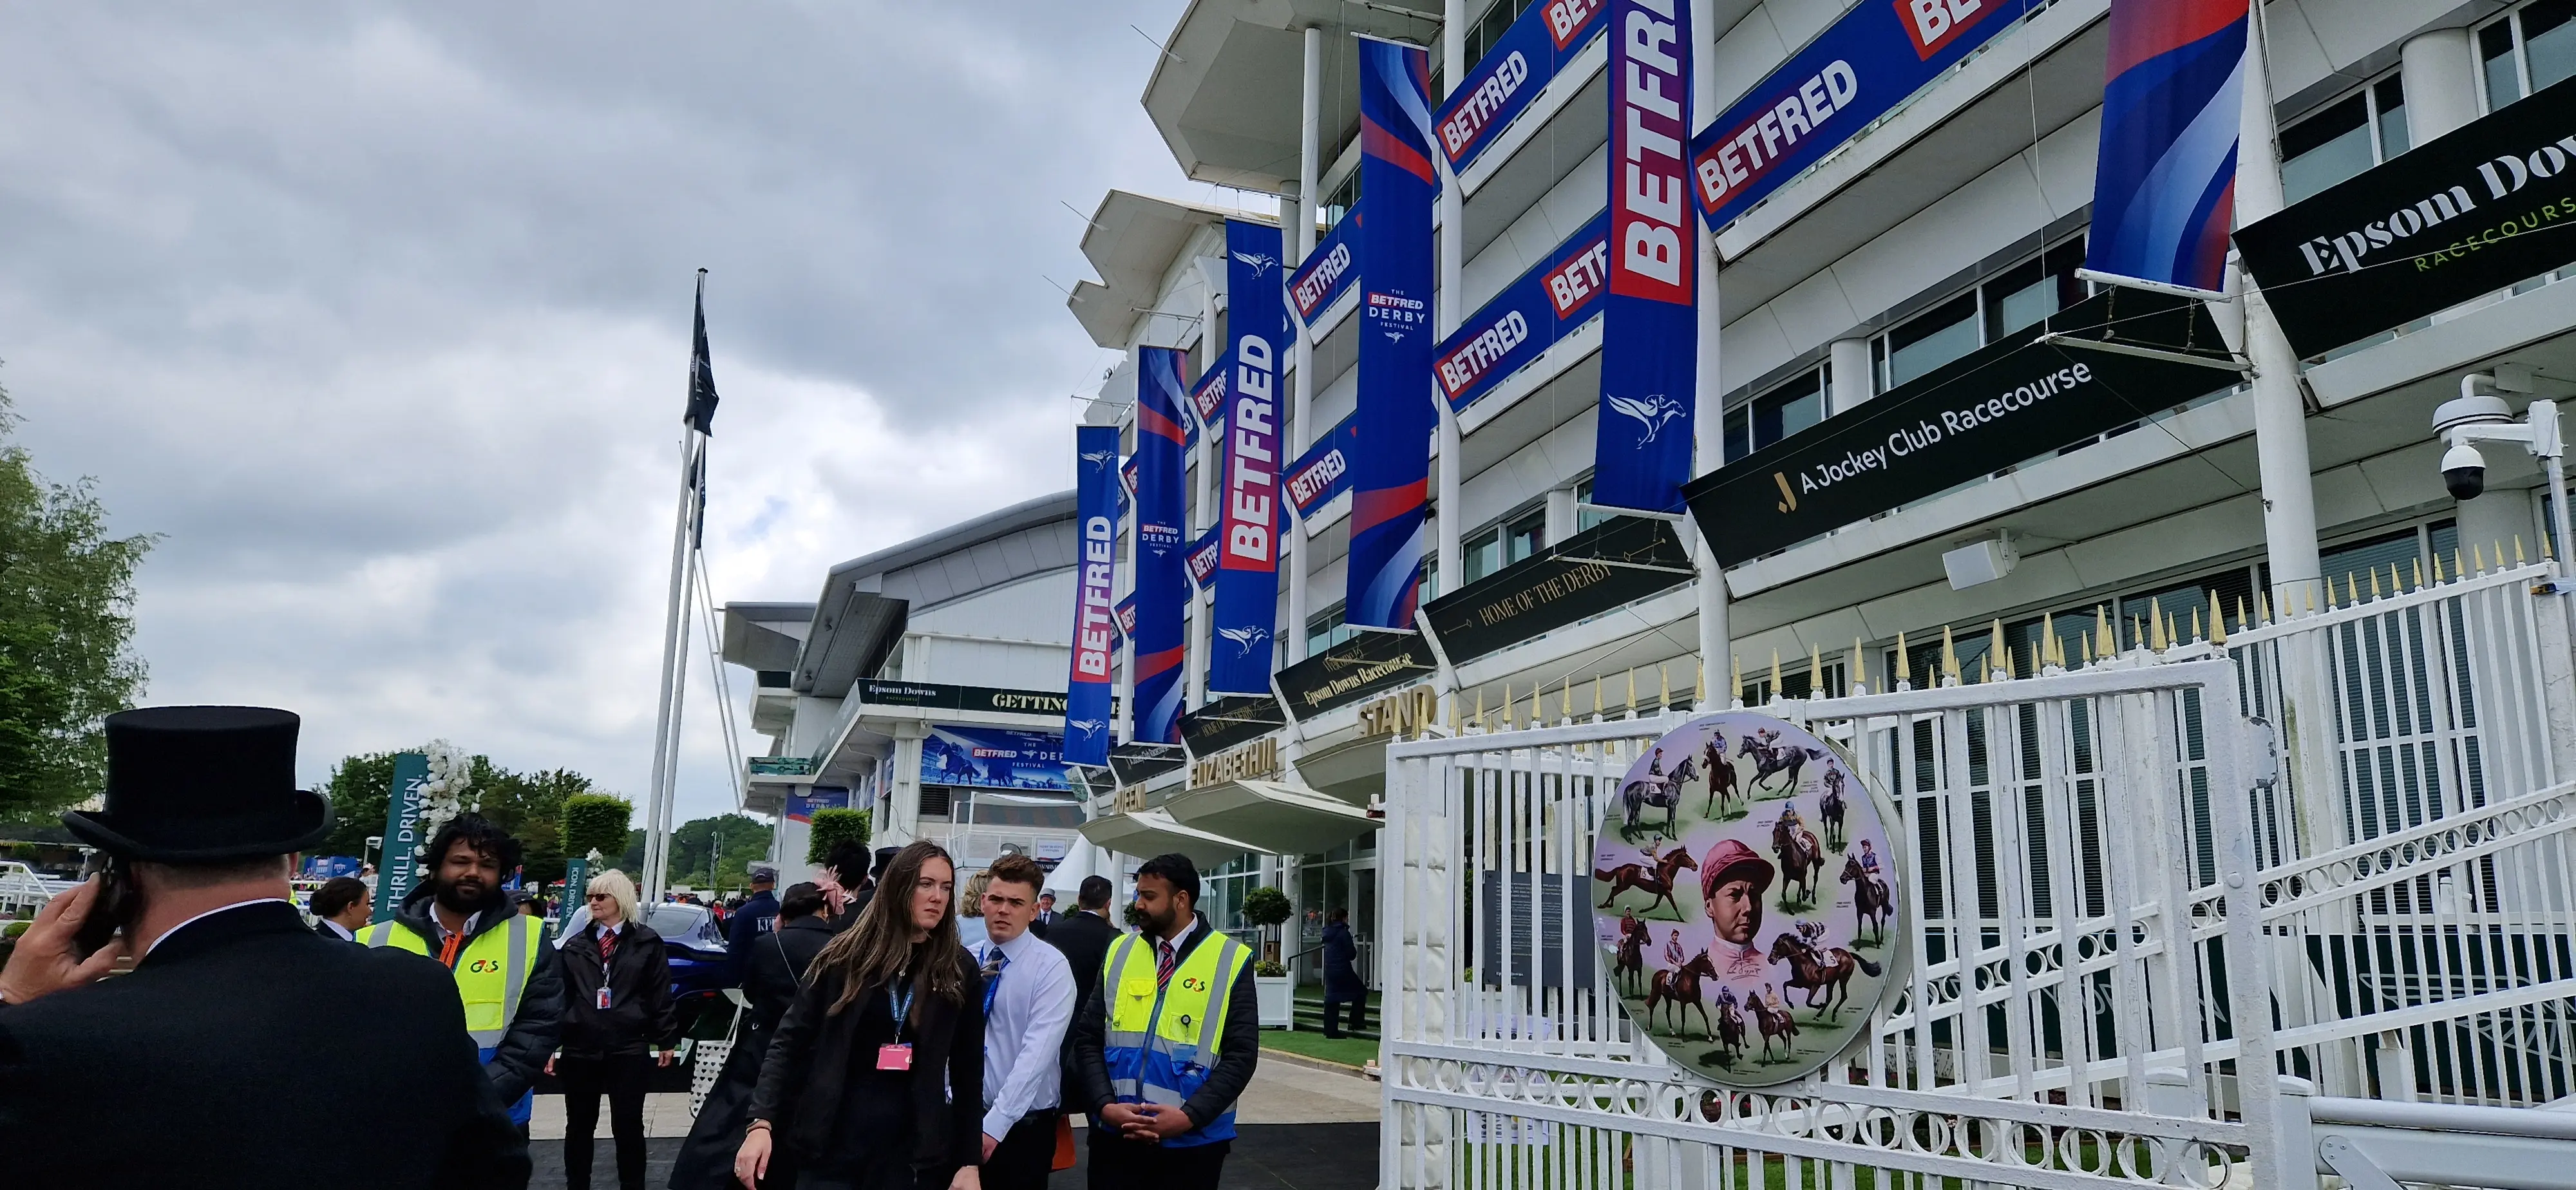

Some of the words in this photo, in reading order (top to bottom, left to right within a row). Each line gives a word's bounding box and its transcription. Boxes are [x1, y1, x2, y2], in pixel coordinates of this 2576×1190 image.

[1443, 50, 1528, 155] BETFRED
[1697, 59, 1857, 203] BETFRED
[1624, 0, 1681, 286] BETFR
[2298, 185, 2477, 276] Epsom
[2414, 197, 2576, 273] RACECOURS
[1295, 242, 1351, 312] BETFRED
[1371, 294, 1424, 310] BETFRED
[1368, 306, 1425, 324] DERBY
[1380, 321, 1414, 331] FESTIVAL
[1440, 310, 1528, 394] BETFRED
[1229, 334, 1274, 563] BETFRED
[1800, 472, 1819, 495] A
[1815, 443, 1888, 487] Jockey
[1888, 419, 1942, 457] Club
[1940, 362, 2092, 436] Racecourse
[1289, 448, 1346, 505] BETFRED
[1142, 525, 1179, 534] BETFRED
[1142, 533, 1179, 543] DERBY
[1079, 516, 1112, 677] BETFRED
[1478, 596, 1519, 627] HOME
[1515, 589, 1535, 612] OF
[1533, 577, 1566, 603] THE
[1564, 559, 1613, 594] DERBY
[869, 685, 902, 695] Epsom
[904, 686, 937, 697] Downs
[1303, 685, 1334, 708] Epsom
[1329, 673, 1361, 695] Downs
[1357, 652, 1414, 685] Racecourse
[1358, 685, 1437, 737] STAND
[973, 748, 1018, 759] BETFRED
[1191, 741, 1260, 789] ELIZABETH
[397, 774, 424, 844] DRIVEN.
[1113, 782, 1146, 814] QUEEN
[386, 847, 412, 912] THRILL.
[469, 959, 499, 974] G4S
[1183, 978, 1205, 992] G4S
